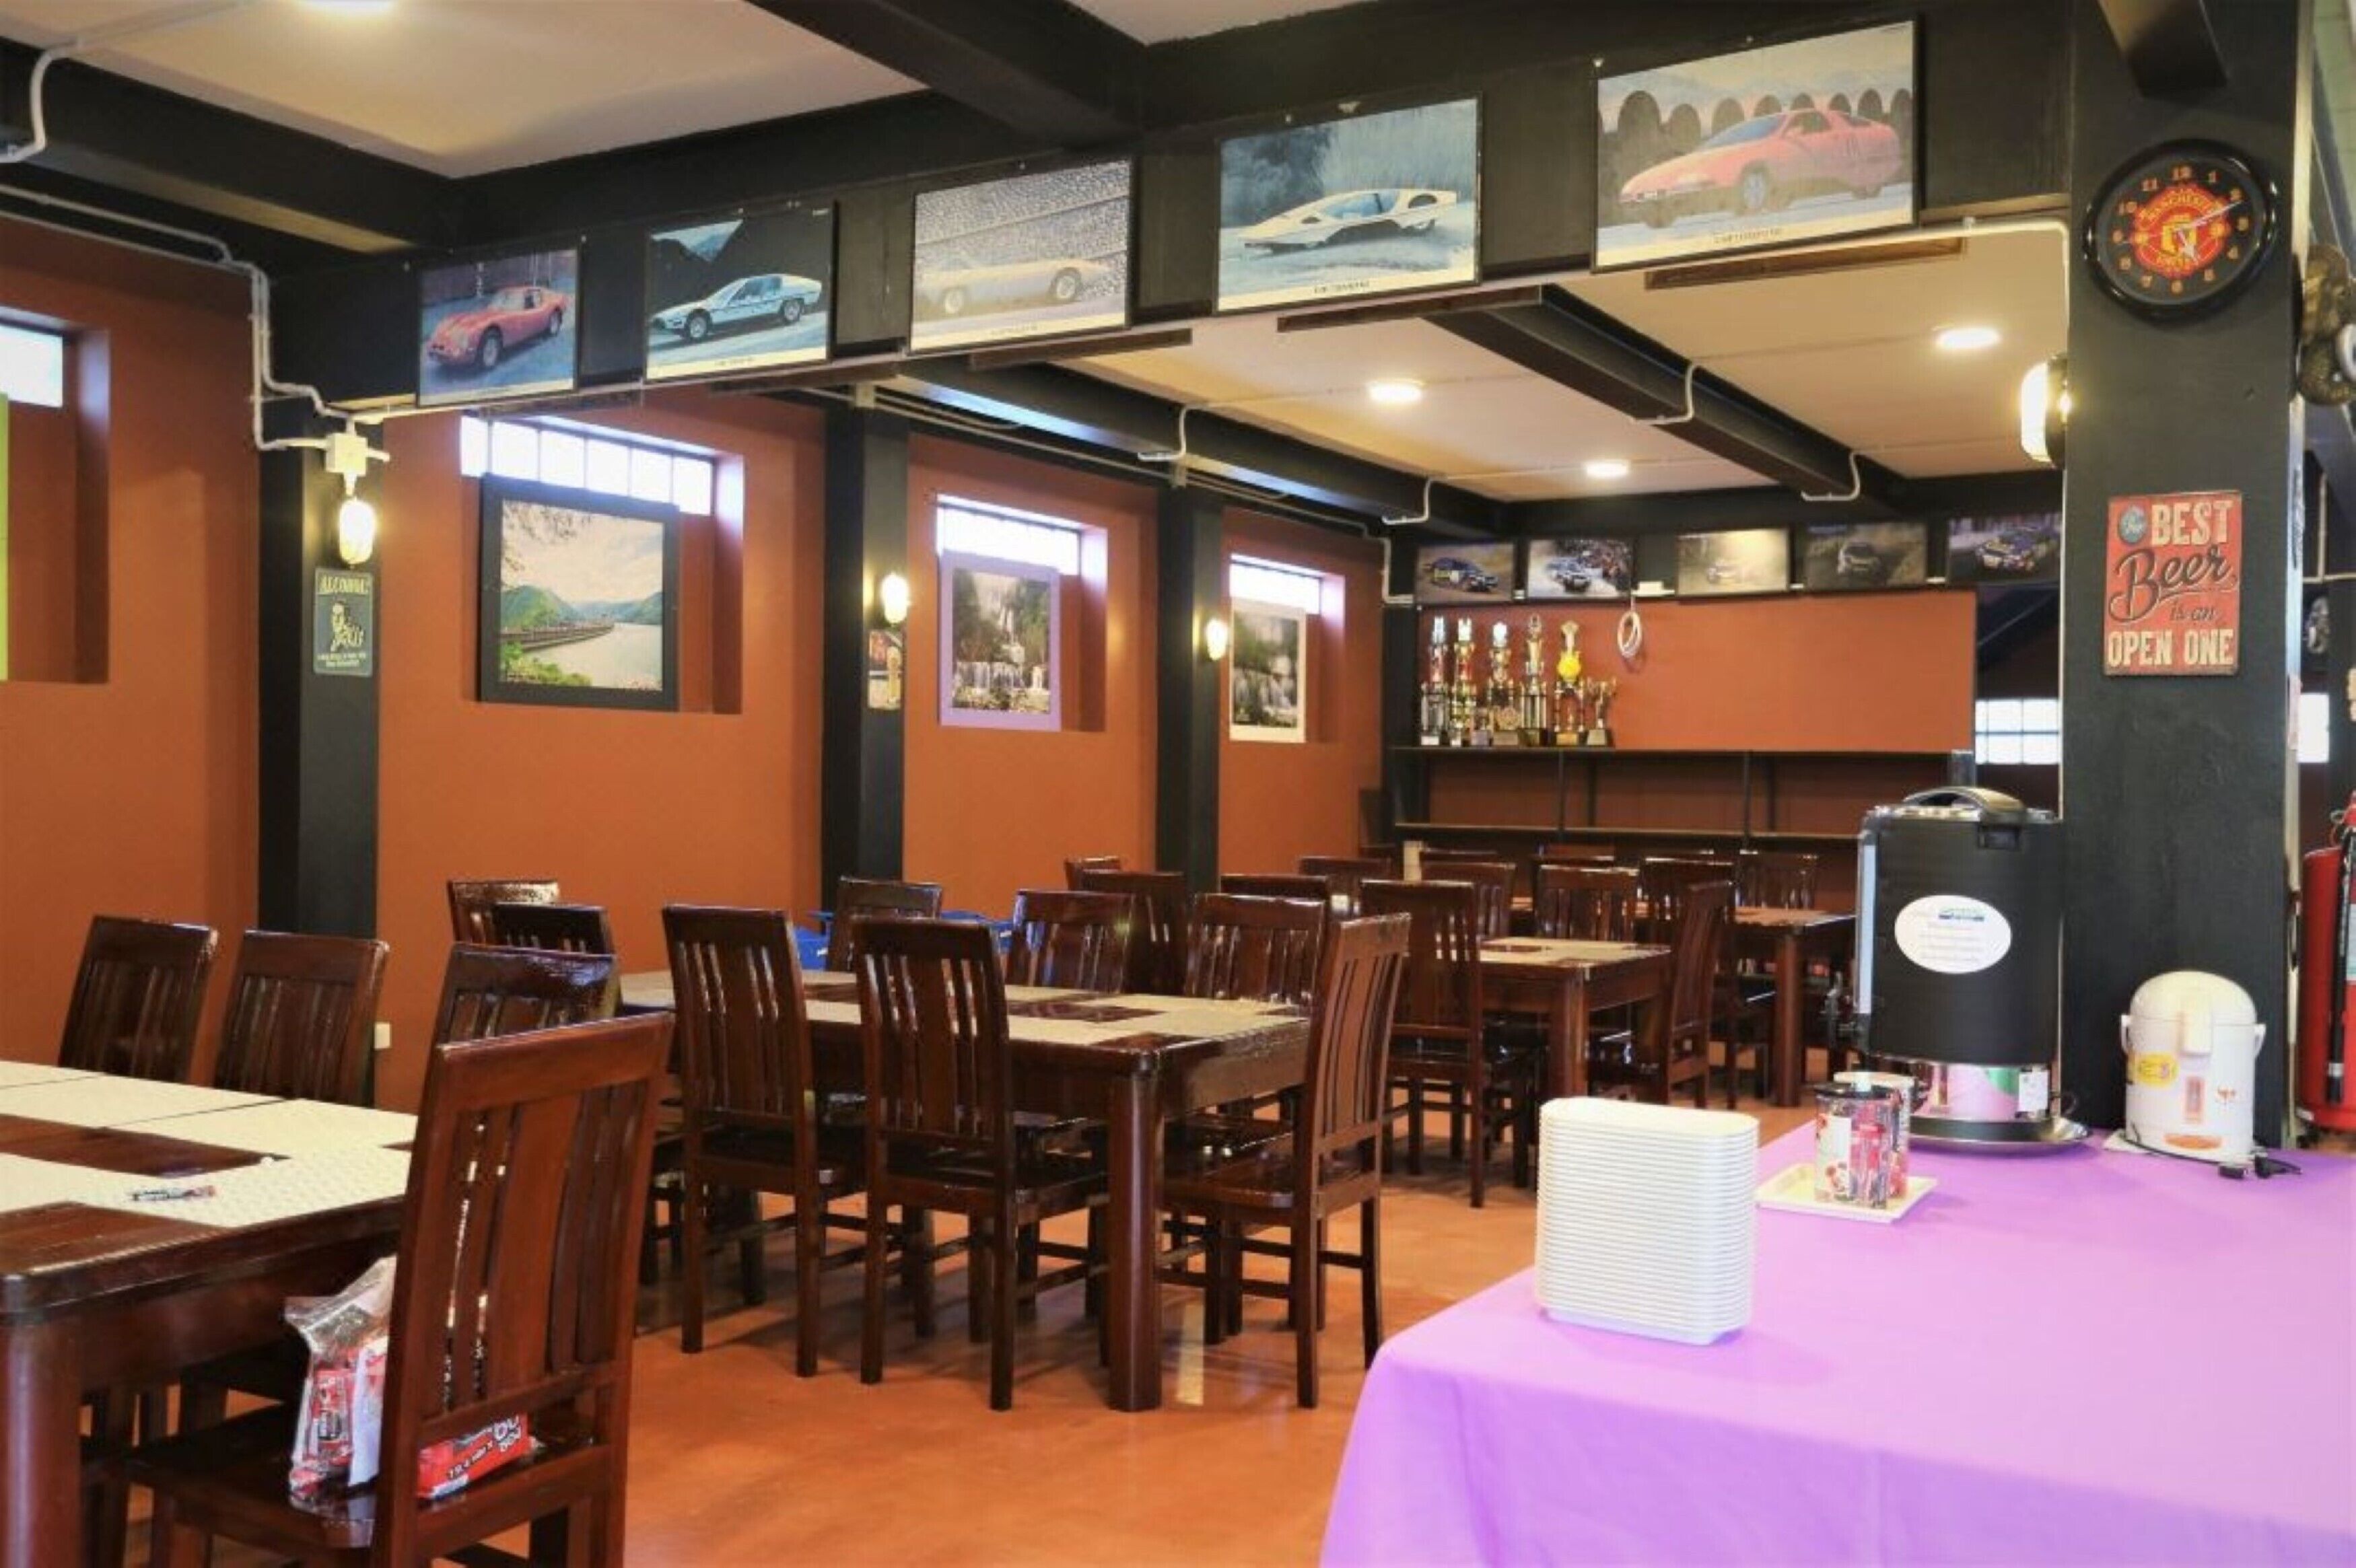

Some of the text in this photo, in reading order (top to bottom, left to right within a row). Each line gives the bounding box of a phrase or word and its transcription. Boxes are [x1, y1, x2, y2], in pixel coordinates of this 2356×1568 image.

[2151, 501, 2233, 545] BEST
[2108, 544, 2237, 623] Beer
[2108, 629, 2234, 667] OPEN ONE
